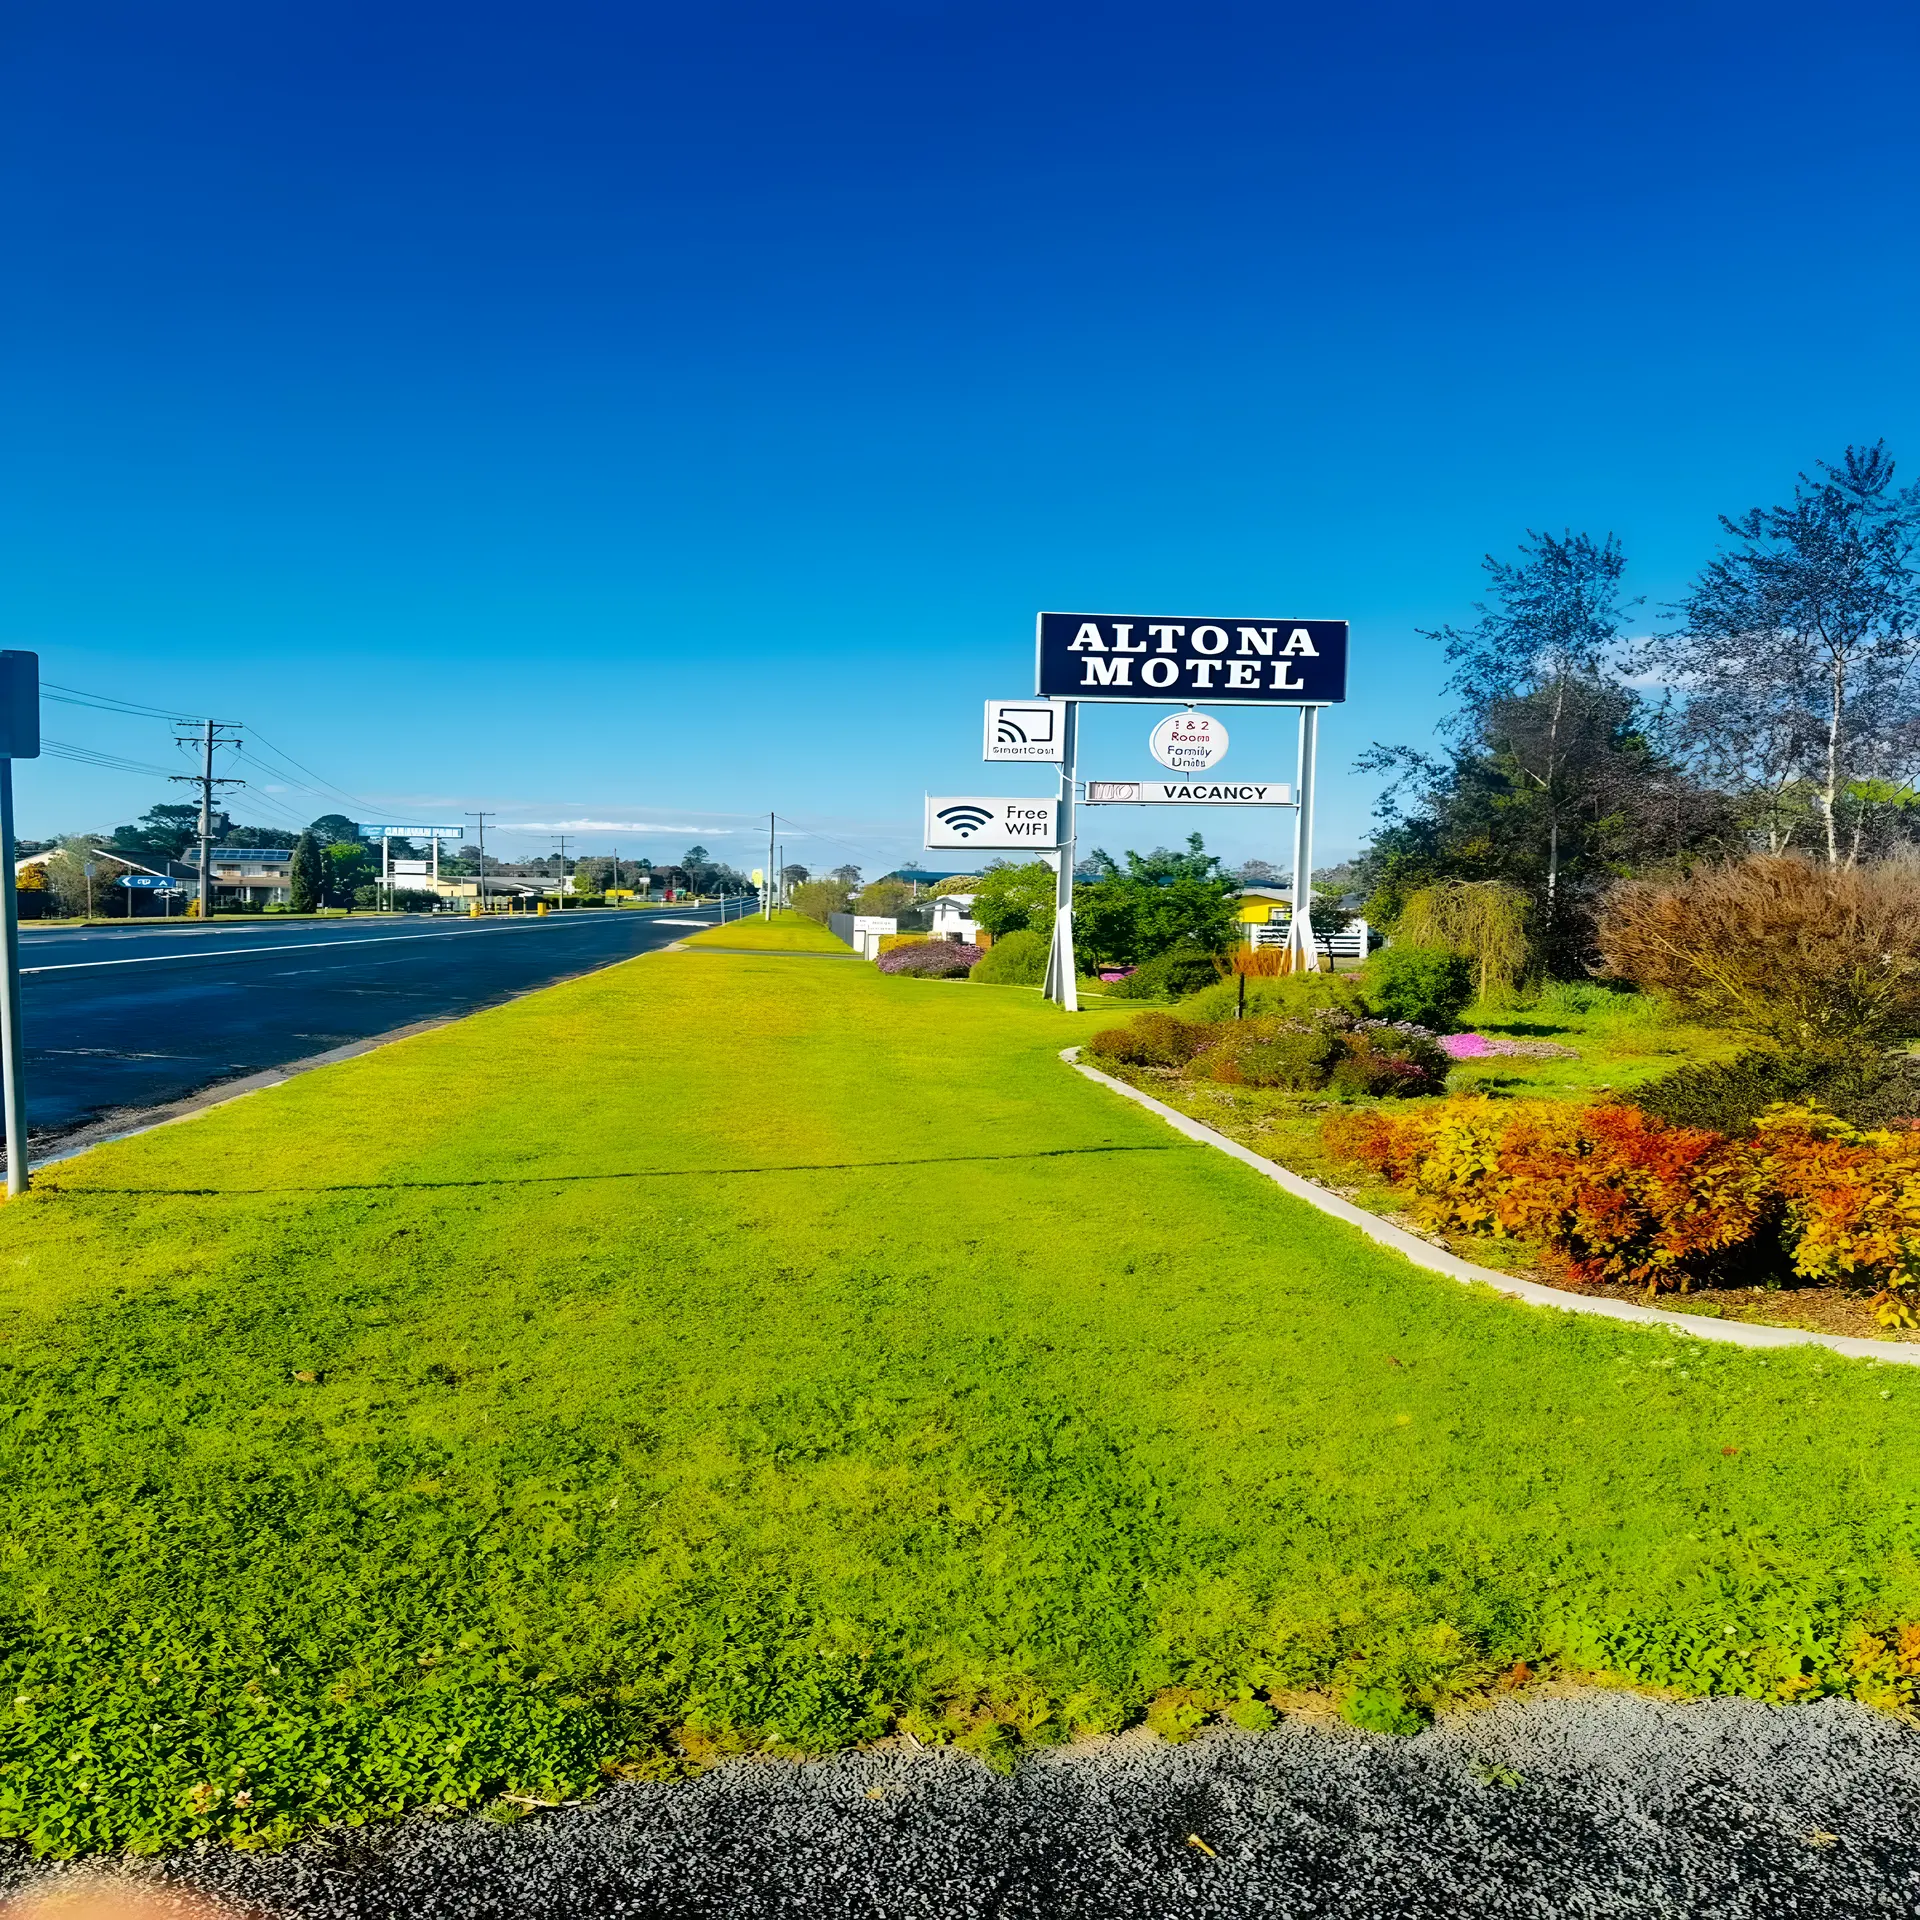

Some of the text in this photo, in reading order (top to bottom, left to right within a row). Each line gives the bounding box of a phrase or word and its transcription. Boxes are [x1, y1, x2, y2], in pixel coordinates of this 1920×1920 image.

[1067, 622, 1320, 657] ALTONA
[1080, 656, 1304, 690] MOTEL
[1186, 720, 1196, 730] &
[1201, 720, 1209, 731] 2
[1167, 745, 1213, 758] Family
[1164, 785, 1268, 800] VACANCY
[1006, 805, 1048, 819] Free
